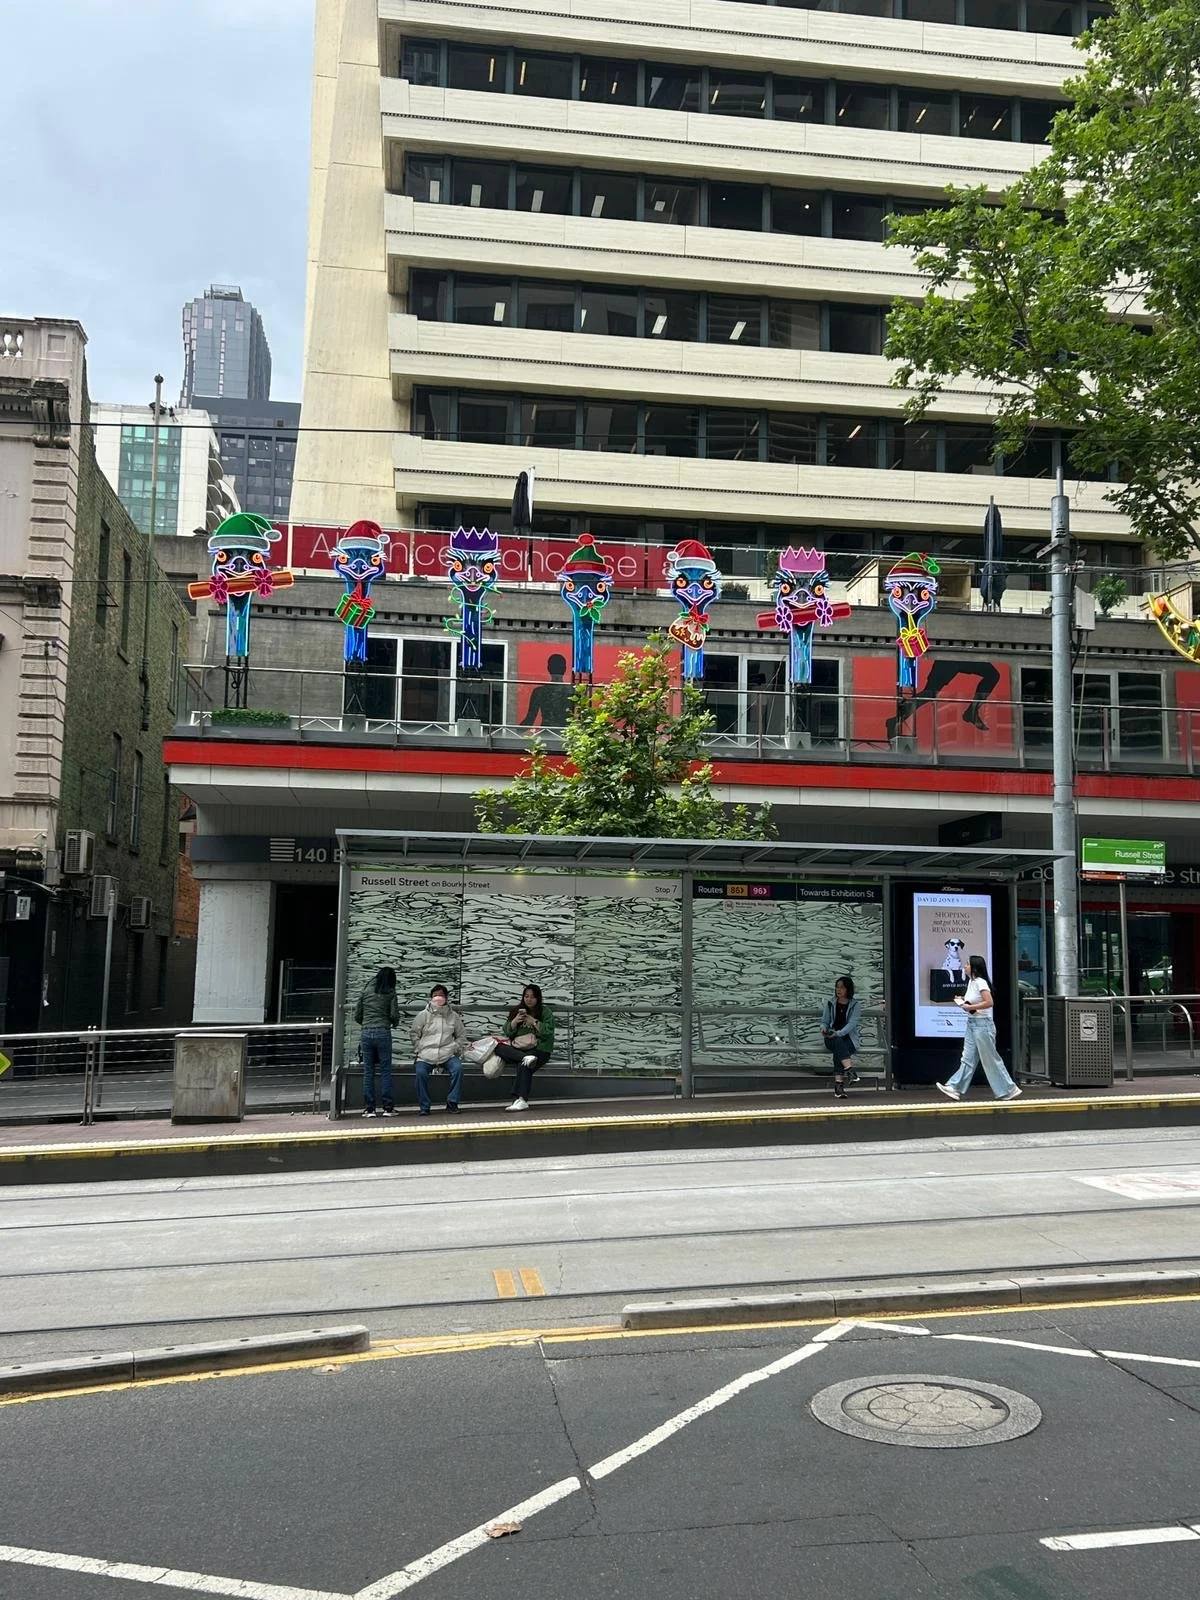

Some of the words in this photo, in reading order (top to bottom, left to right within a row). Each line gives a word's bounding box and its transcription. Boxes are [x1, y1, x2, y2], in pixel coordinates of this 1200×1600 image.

[295, 847, 327, 862] 140
[1114, 850, 1140, 859] Russell
[1142, 851, 1164, 860] Street
[361, 877, 396, 886] Russell
[398, 877, 430, 887] Street
[442, 880, 467, 888] Bourke
[468, 881, 490, 889] Street
[655, 886, 671, 894] Stop
[672, 885, 678, 893] 7
[698, 885, 723, 894] Routes
[752, 887, 763, 895] 96
[800, 888, 830, 897] Towards
[831, 889, 865, 898] Exhibition
[866, 890, 875, 898] St
[935, 911, 970, 919] SHOPPING
[932, 926, 974, 934] REWARDING
